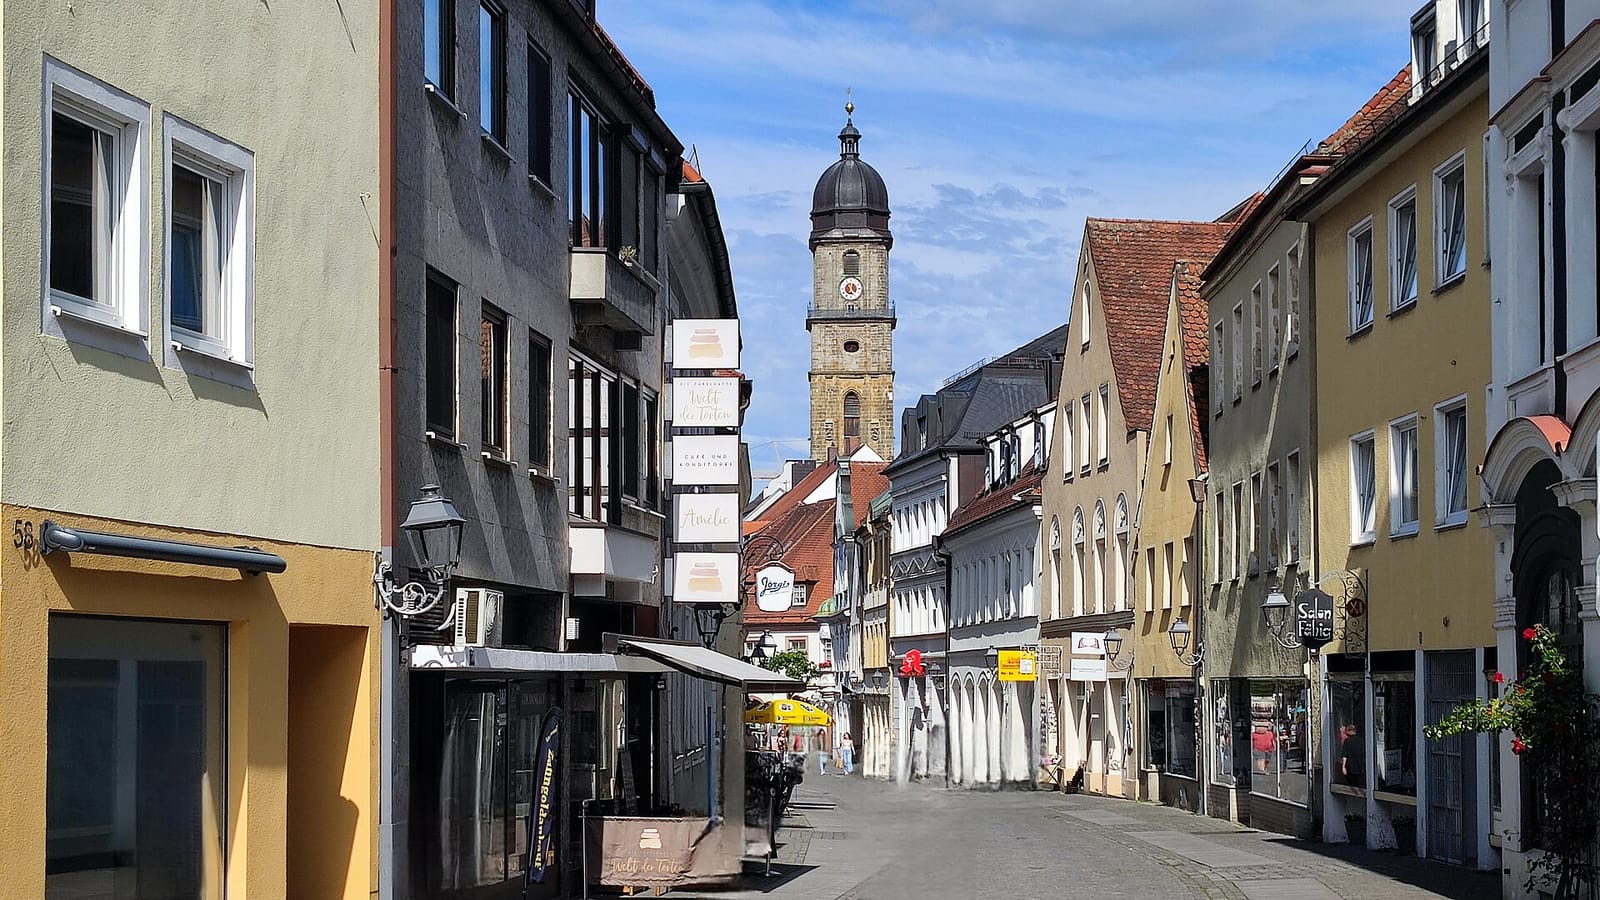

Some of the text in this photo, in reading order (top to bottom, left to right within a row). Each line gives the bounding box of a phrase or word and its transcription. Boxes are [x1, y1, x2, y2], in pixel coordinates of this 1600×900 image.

[689, 387, 722, 405] Welt
[680, 405, 731, 421] der Torten
[14, 520, 33, 549] 58
[610, 857, 640, 873] Welt
